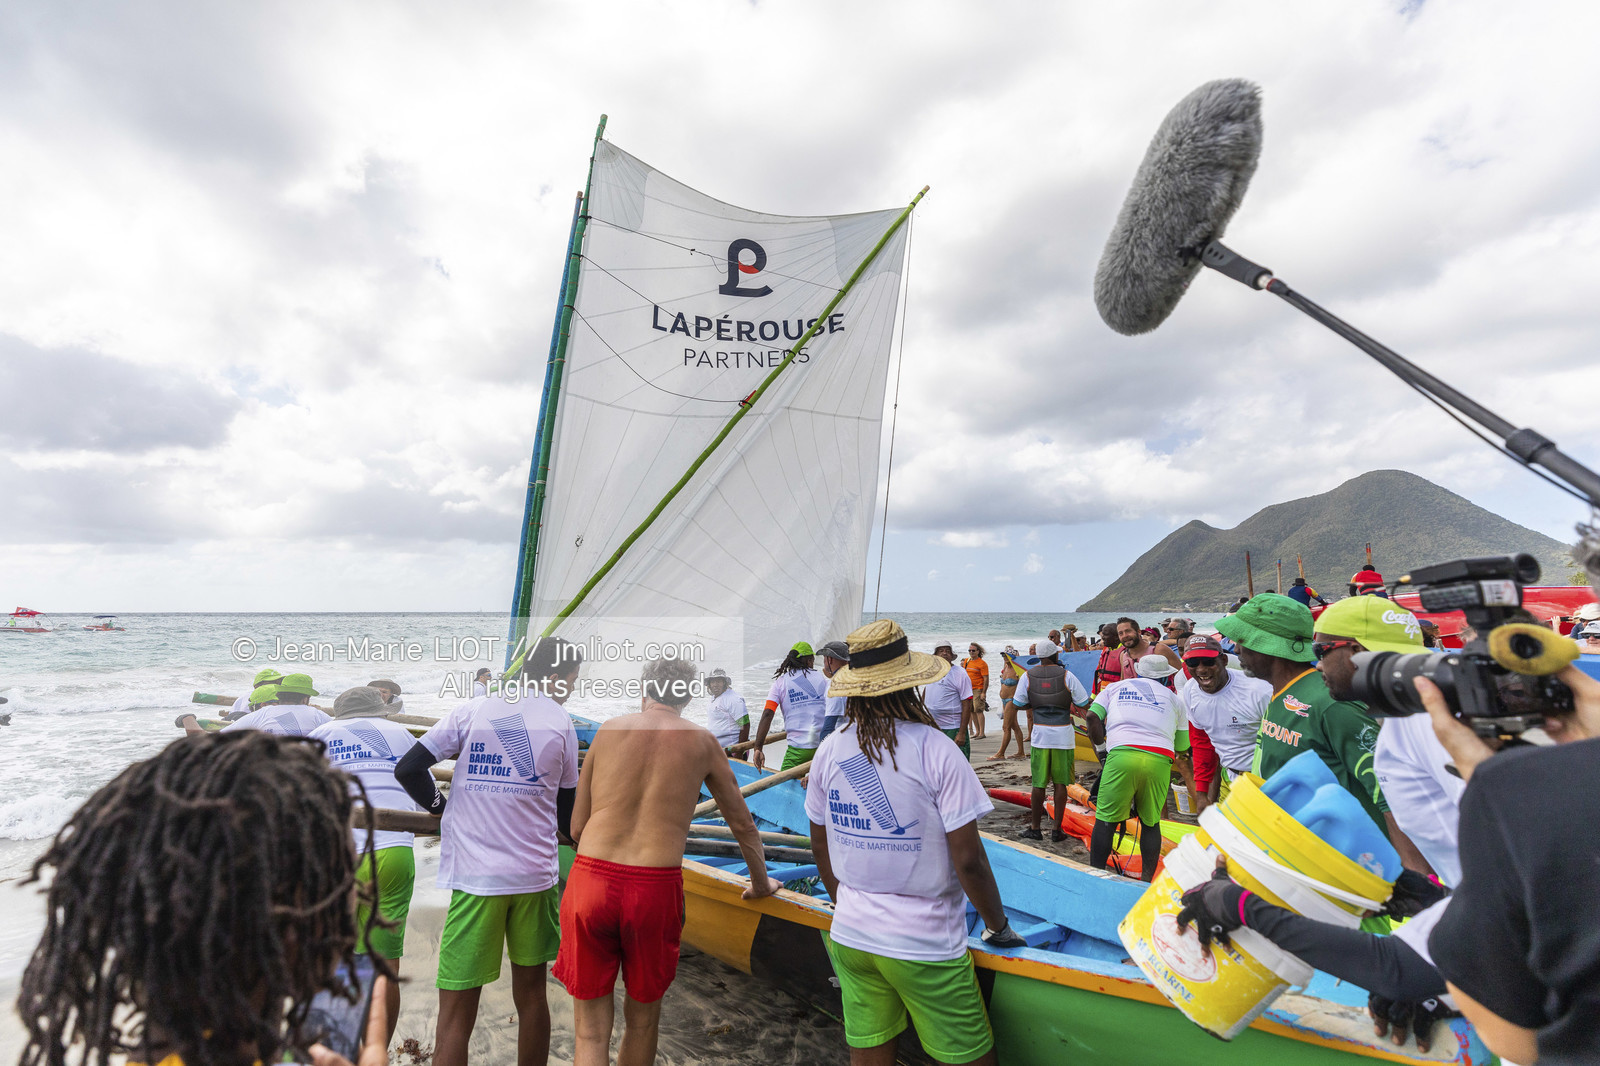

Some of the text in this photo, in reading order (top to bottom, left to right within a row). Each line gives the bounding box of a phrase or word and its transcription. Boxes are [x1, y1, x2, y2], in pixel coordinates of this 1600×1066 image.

[652, 304, 845, 342] LAPÉROUSE
[330, 739, 344, 747] LES
[470, 742, 485, 752] LES
[469, 752, 503, 765] BARRÉS
[468, 764, 512, 777] DE LA YOLE
[474, 783, 490, 792] DÉFI
[491, 785, 501, 793] DE
[502, 787, 545, 797] MARTINIQUE
[828, 789, 840, 801] LES
[829, 801, 859, 816] BARRÉS
[831, 813, 871, 830] DE LA YOLE
[855, 841, 866, 850] DE
[867, 842, 922, 852] MARTINIQUE
[1136, 937, 1196, 1003] MARGARINE
